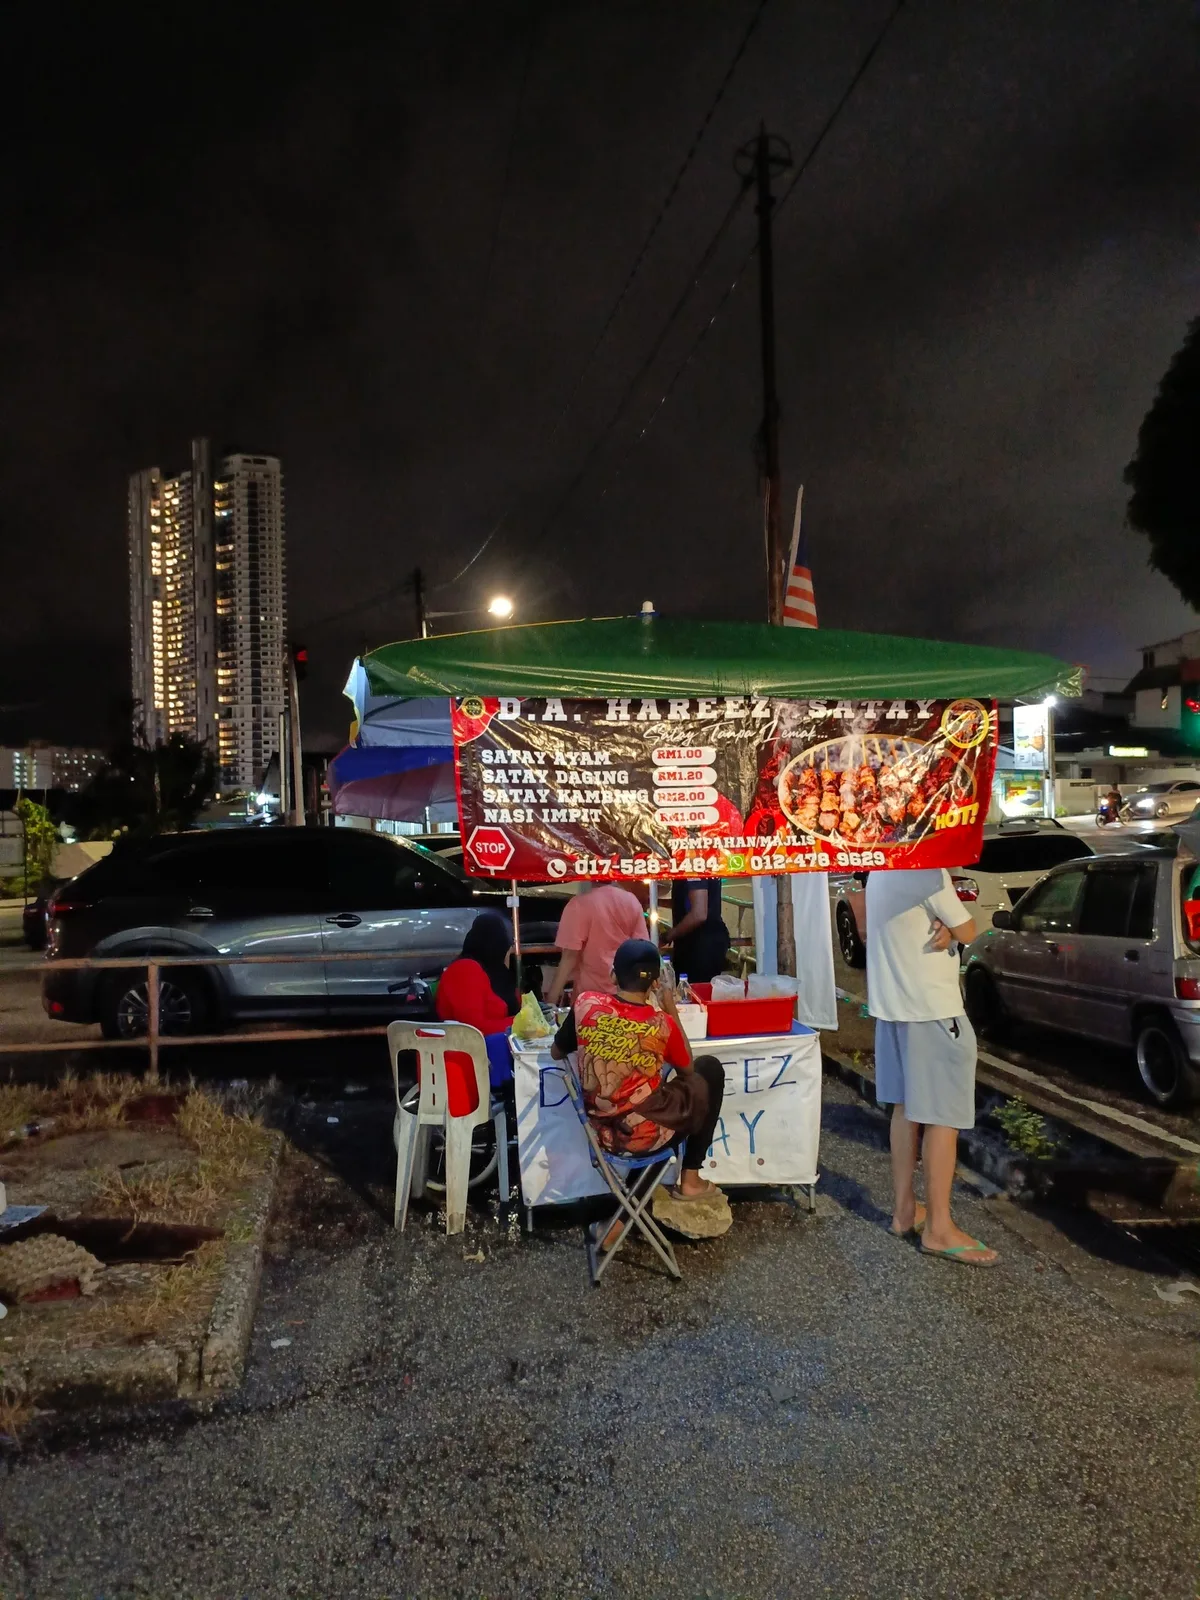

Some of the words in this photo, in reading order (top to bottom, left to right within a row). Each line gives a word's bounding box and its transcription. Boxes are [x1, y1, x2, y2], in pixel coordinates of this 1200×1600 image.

[606, 696, 771, 721] HAREEZ
[808, 698, 936, 719] SATAY
[643, 722, 700, 747] Satay
[481, 749, 547, 765] SATAY
[553, 750, 613, 766] AYAM
[657, 749, 702, 759] RM1.00
[482, 769, 548, 784] SATAY
[556, 770, 629, 785] DAGING
[658, 771, 703, 781] RM1.20
[483, 789, 549, 804] SATAY
[557, 789, 649, 804] KAMBING
[657, 792, 705, 802] RM2.00
[484, 808, 534, 824] NASI
[542, 807, 603, 823] IMPIT
[660, 811, 706, 822] RM1.00
[935, 802, 980, 831] HOT!
[475, 842, 506, 854] STOP
[574, 856, 720, 875] 017-528-1484
[836, 851, 885, 867] 9629
[597, 1015, 660, 1037] GARDEN
[577, 1024, 639, 1050] CAMERON
[585, 1042, 657, 1067] HIGHLAND
